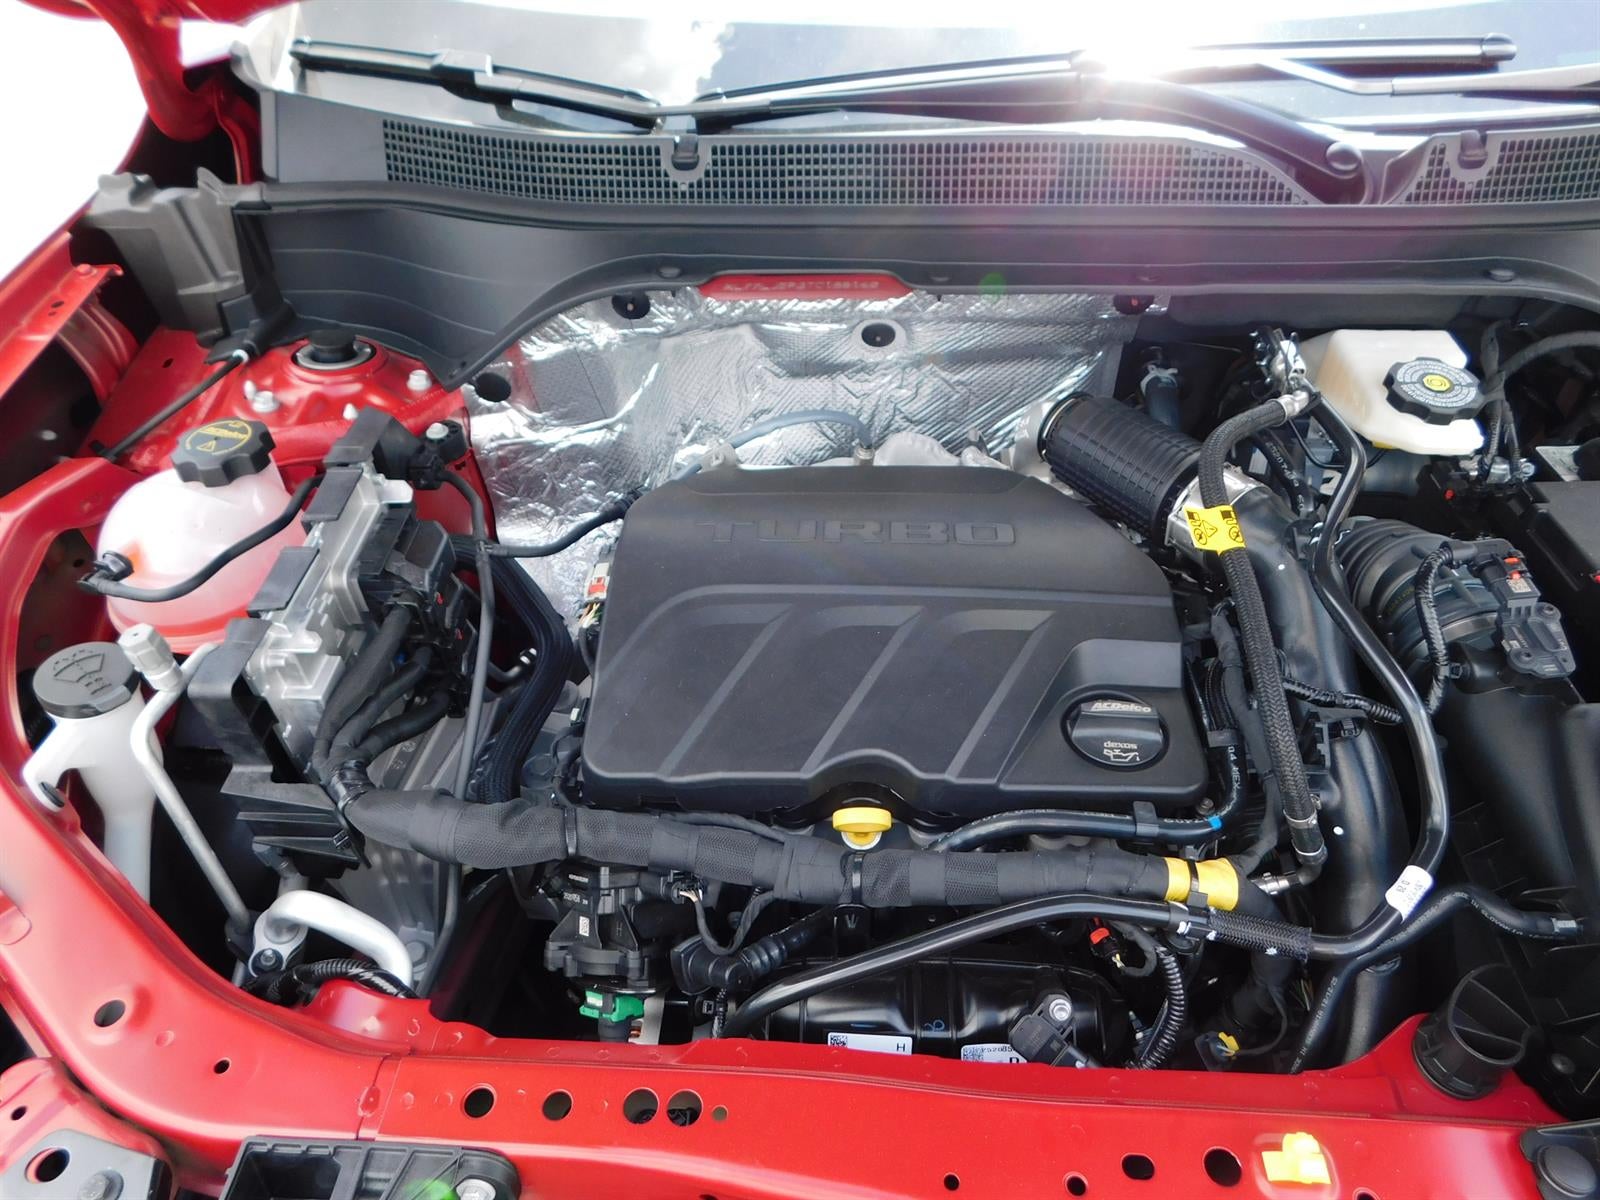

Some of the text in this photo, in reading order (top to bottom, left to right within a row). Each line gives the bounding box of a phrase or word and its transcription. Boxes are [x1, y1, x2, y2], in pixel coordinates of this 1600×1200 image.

[696, 519, 1016, 545] TURBO
[1091, 701, 1152, 713] ACDelco
[1103, 741, 1138, 750] dexos
[896, 1042, 906, 1052] H
